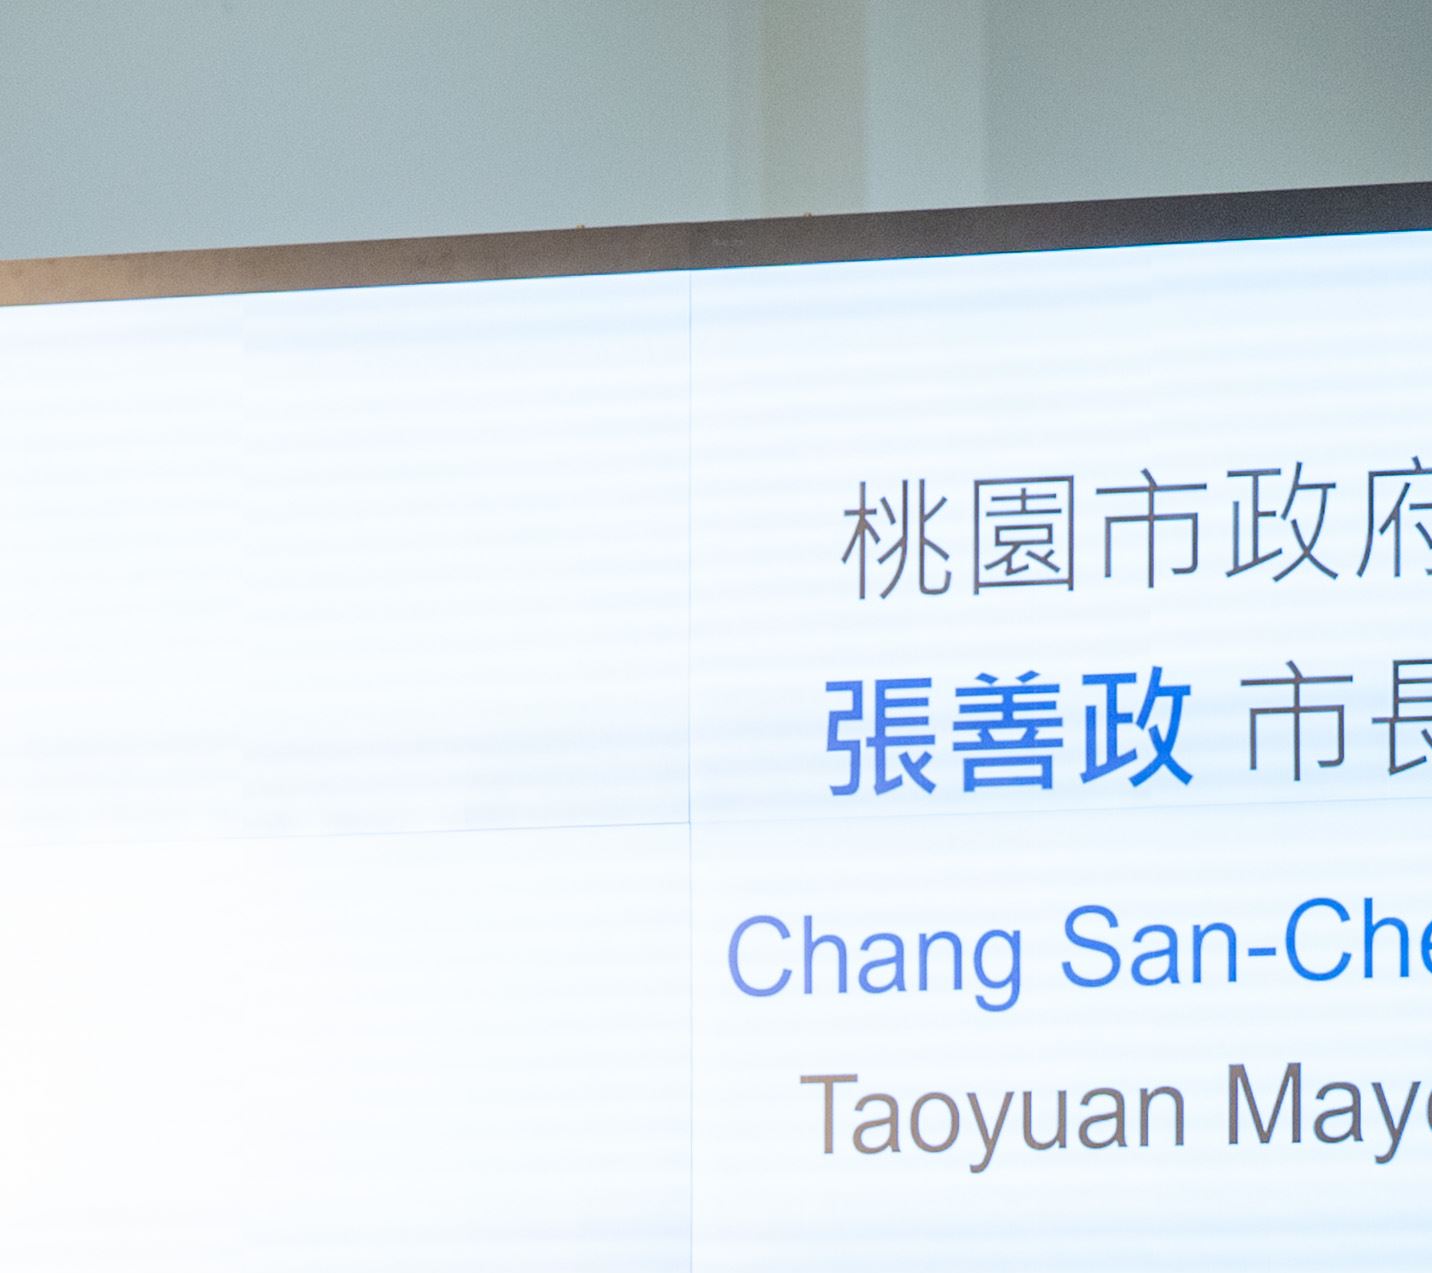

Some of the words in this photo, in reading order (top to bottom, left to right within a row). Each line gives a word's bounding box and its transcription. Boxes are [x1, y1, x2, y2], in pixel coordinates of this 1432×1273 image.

[825, 665, 1194, 796] 張善政
[727, 914, 1022, 1012] Chang
[800, 1074, 1184, 1174] Taoyuan
